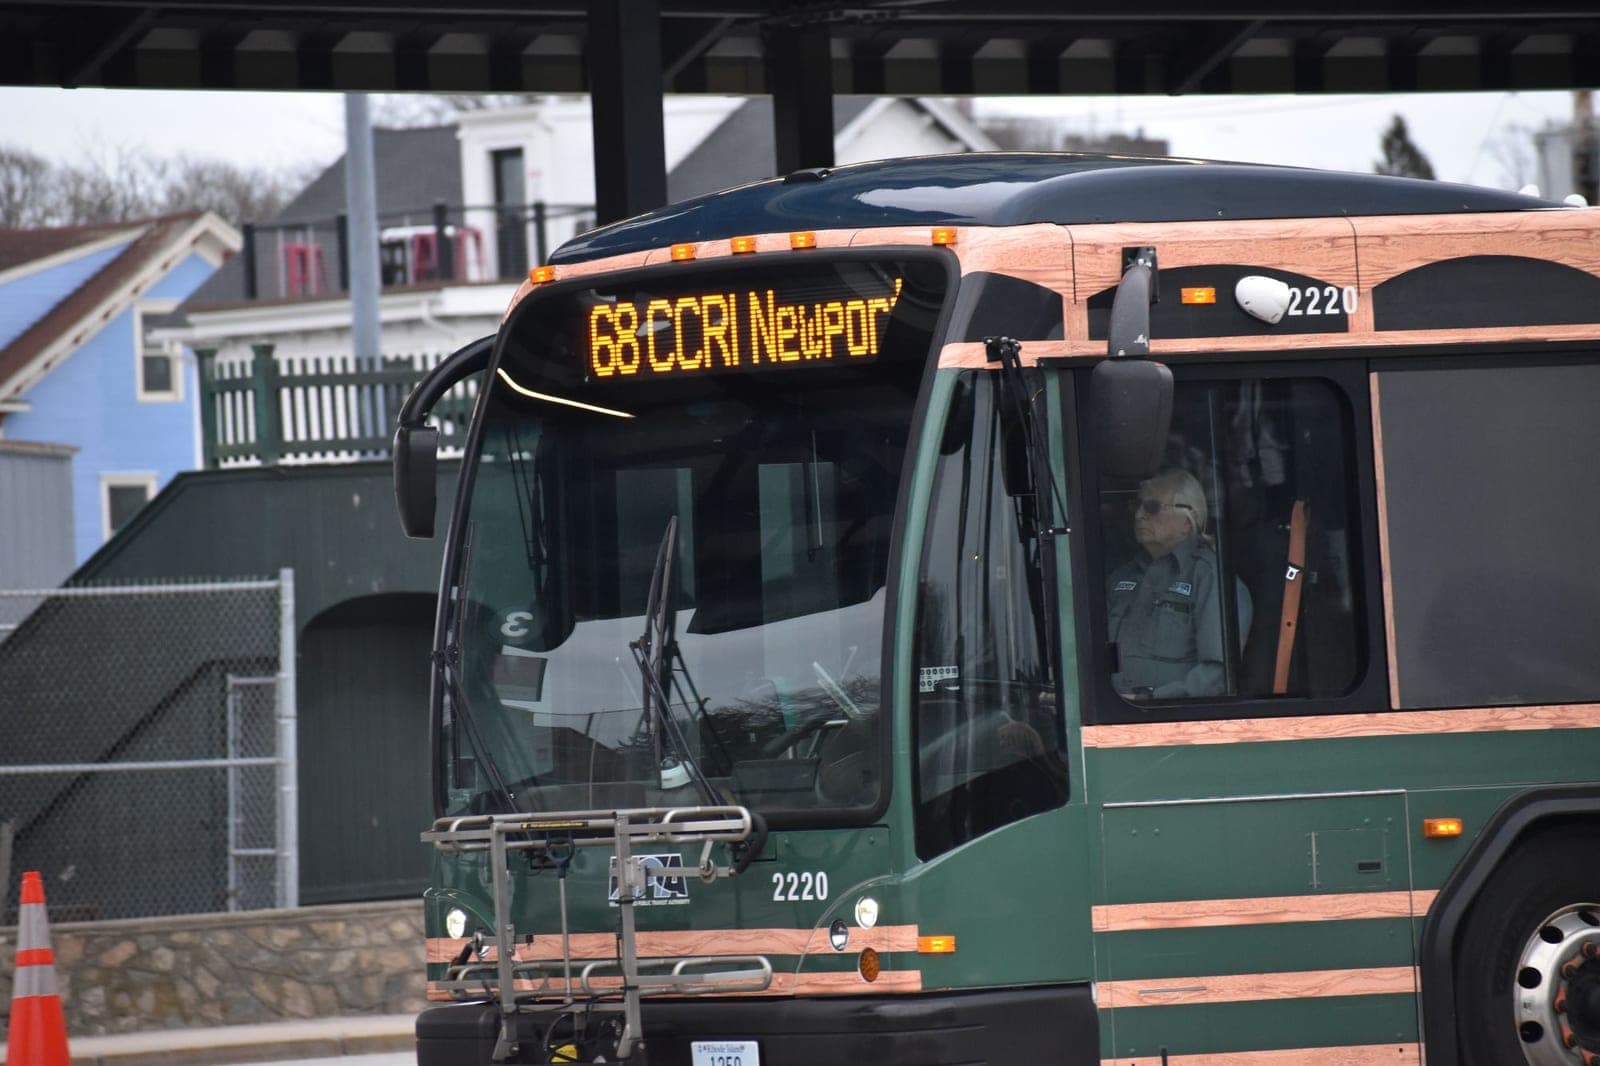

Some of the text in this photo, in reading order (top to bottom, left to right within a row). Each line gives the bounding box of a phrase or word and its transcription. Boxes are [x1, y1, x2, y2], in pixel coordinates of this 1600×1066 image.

[1287, 285, 1358, 315] 2220
[590, 302, 640, 377] 68
[646, 293, 740, 372] CCRI
[771, 871, 829, 901] 2220
